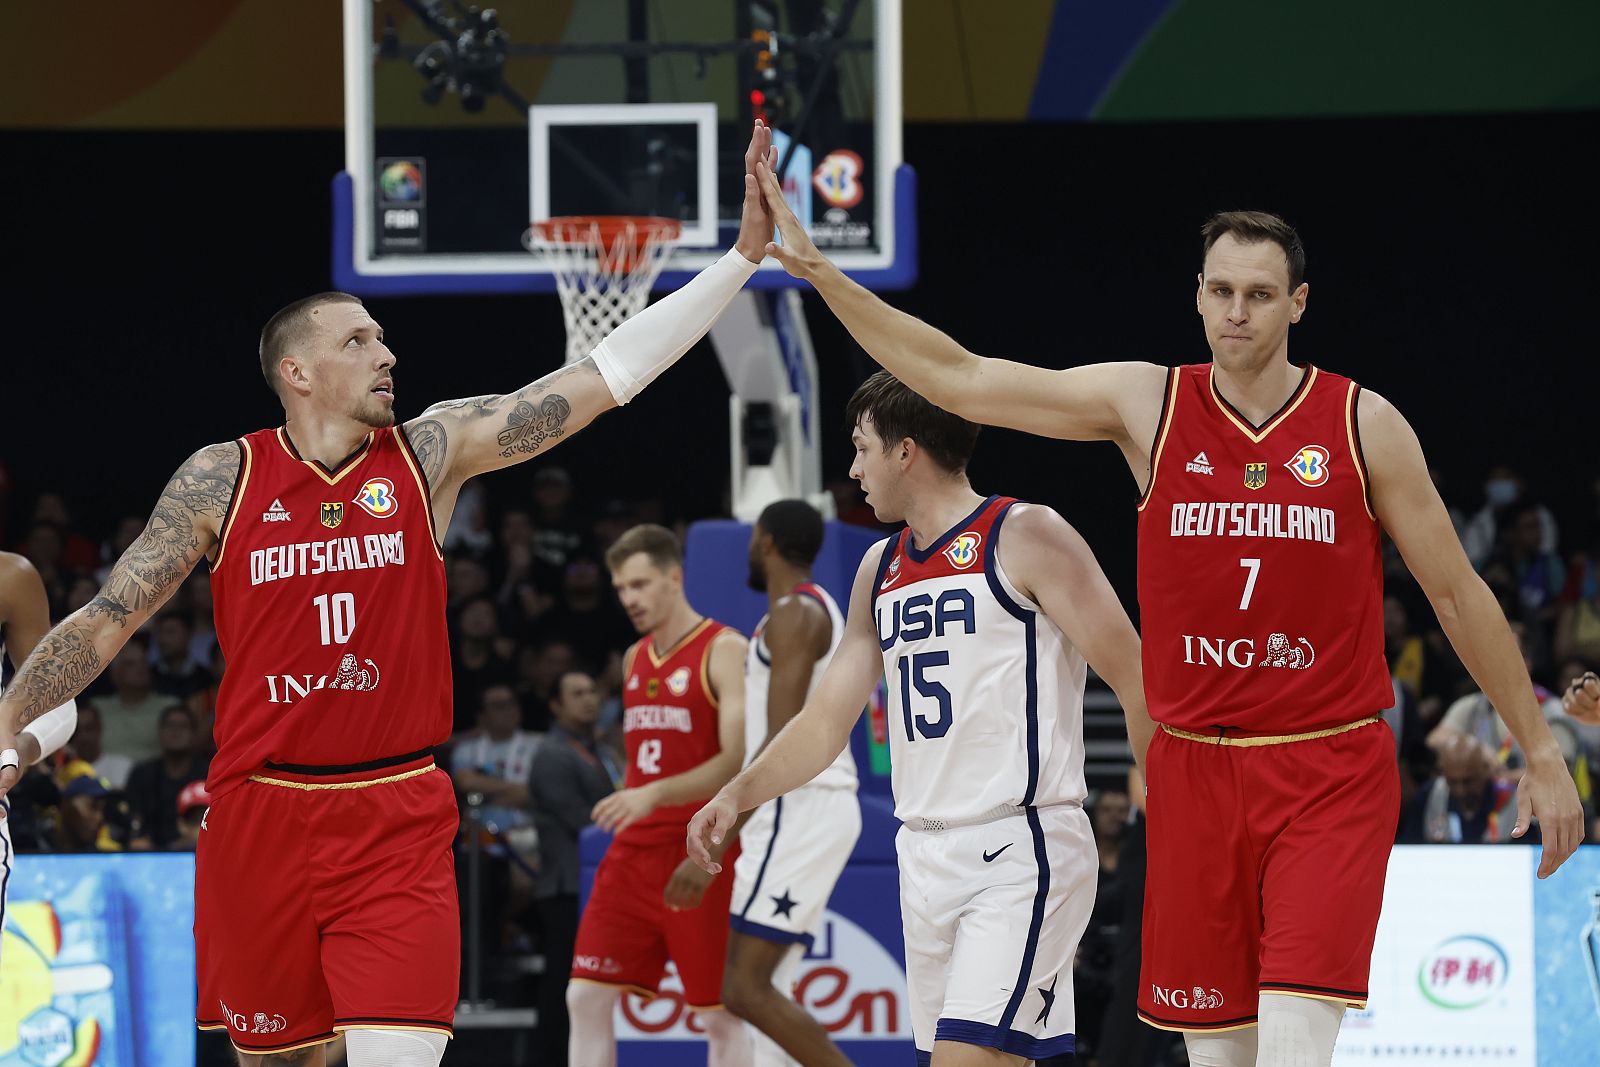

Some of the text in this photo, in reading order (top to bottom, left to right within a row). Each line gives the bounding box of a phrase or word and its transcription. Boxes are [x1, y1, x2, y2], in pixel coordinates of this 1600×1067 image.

[1185, 461, 1214, 476] PEAK
[262, 511, 291, 522] PEAK
[1170, 502, 1336, 544] DEUTSCHLAND
[1239, 558, 1261, 610] 7
[313, 592, 356, 645] 10
[878, 588, 976, 652] USA
[1181, 634, 1255, 668] ING
[898, 650, 953, 742] 15
[637, 739, 662, 774] 42
